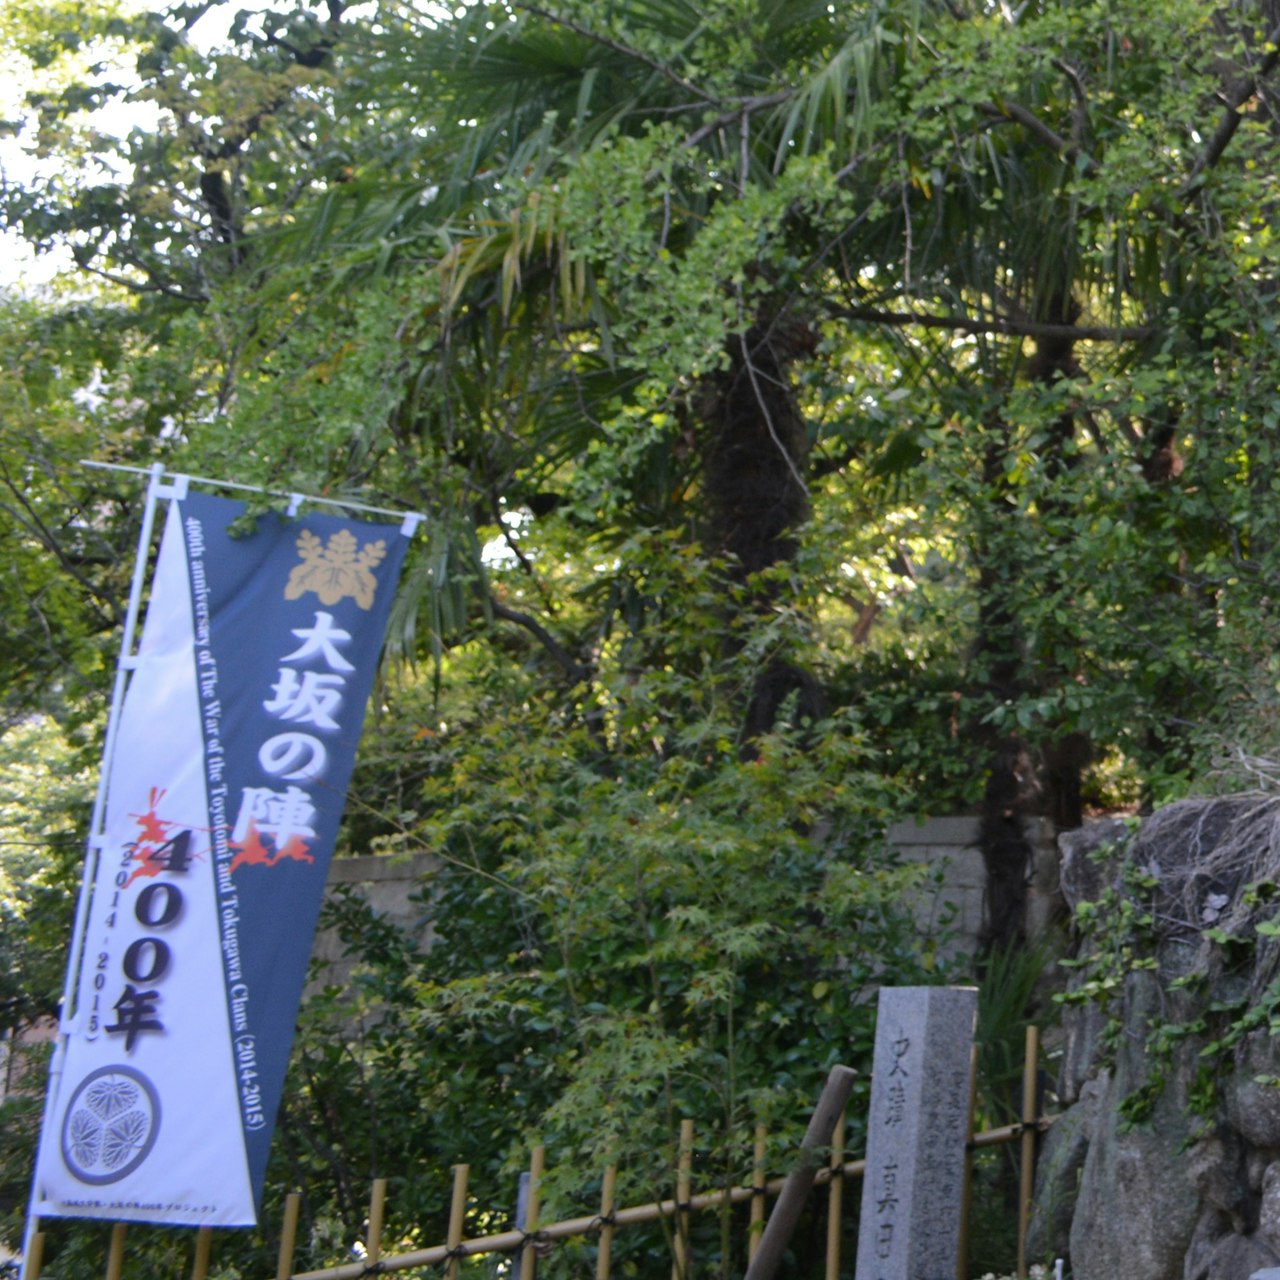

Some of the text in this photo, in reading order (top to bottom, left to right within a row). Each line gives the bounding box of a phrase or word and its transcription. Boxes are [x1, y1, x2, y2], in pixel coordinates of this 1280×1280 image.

[186, 517, 267, 1131] 400th anniversary of The War of the Toyotomi and Tokugawa Clans (2014-2015)
[231, 610, 357, 851] 大坂の陣
[104, 828, 193, 1053] 400年
